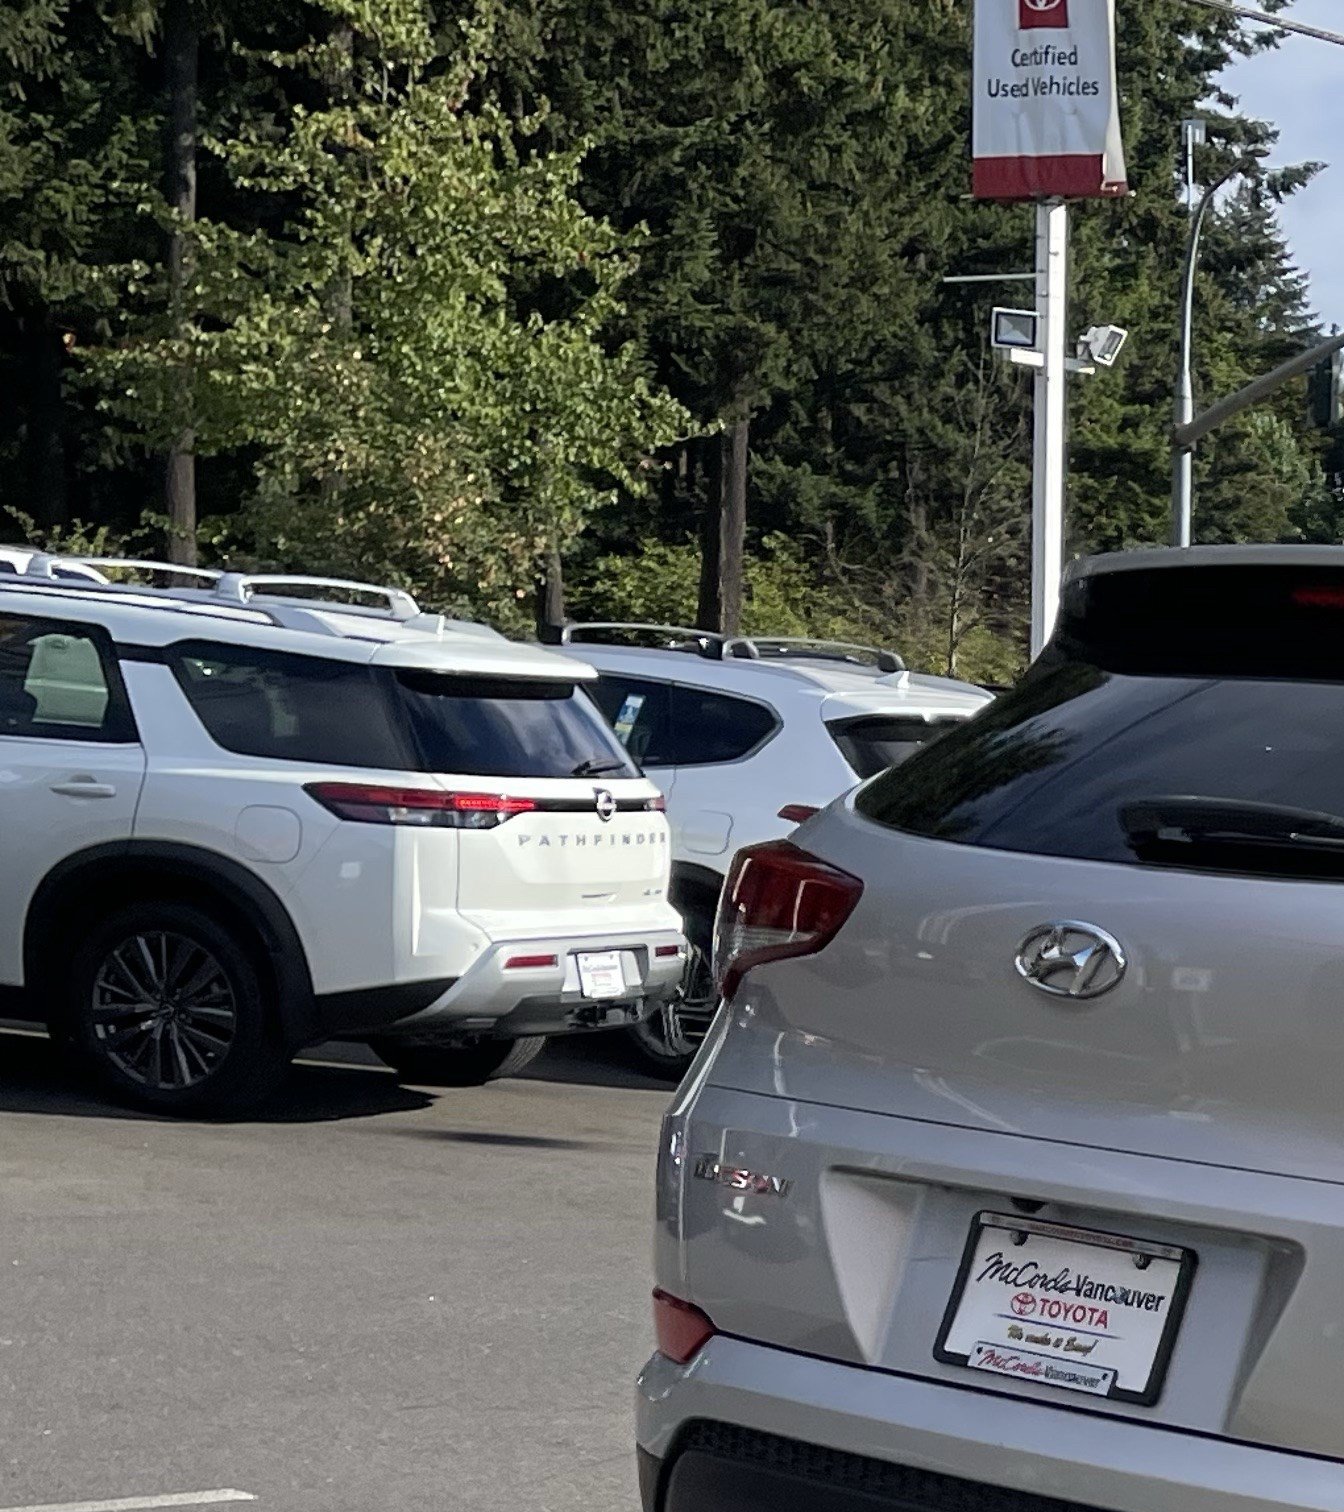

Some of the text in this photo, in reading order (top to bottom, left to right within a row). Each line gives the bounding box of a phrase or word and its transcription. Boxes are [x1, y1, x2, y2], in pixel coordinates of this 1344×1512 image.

[1011, 45, 1078, 67] Certified
[987, 75, 1099, 98] Used Vehicles
[517, 831, 666, 847] PATHFINDER
[1039, 1298, 1109, 1329] TOYOTA
